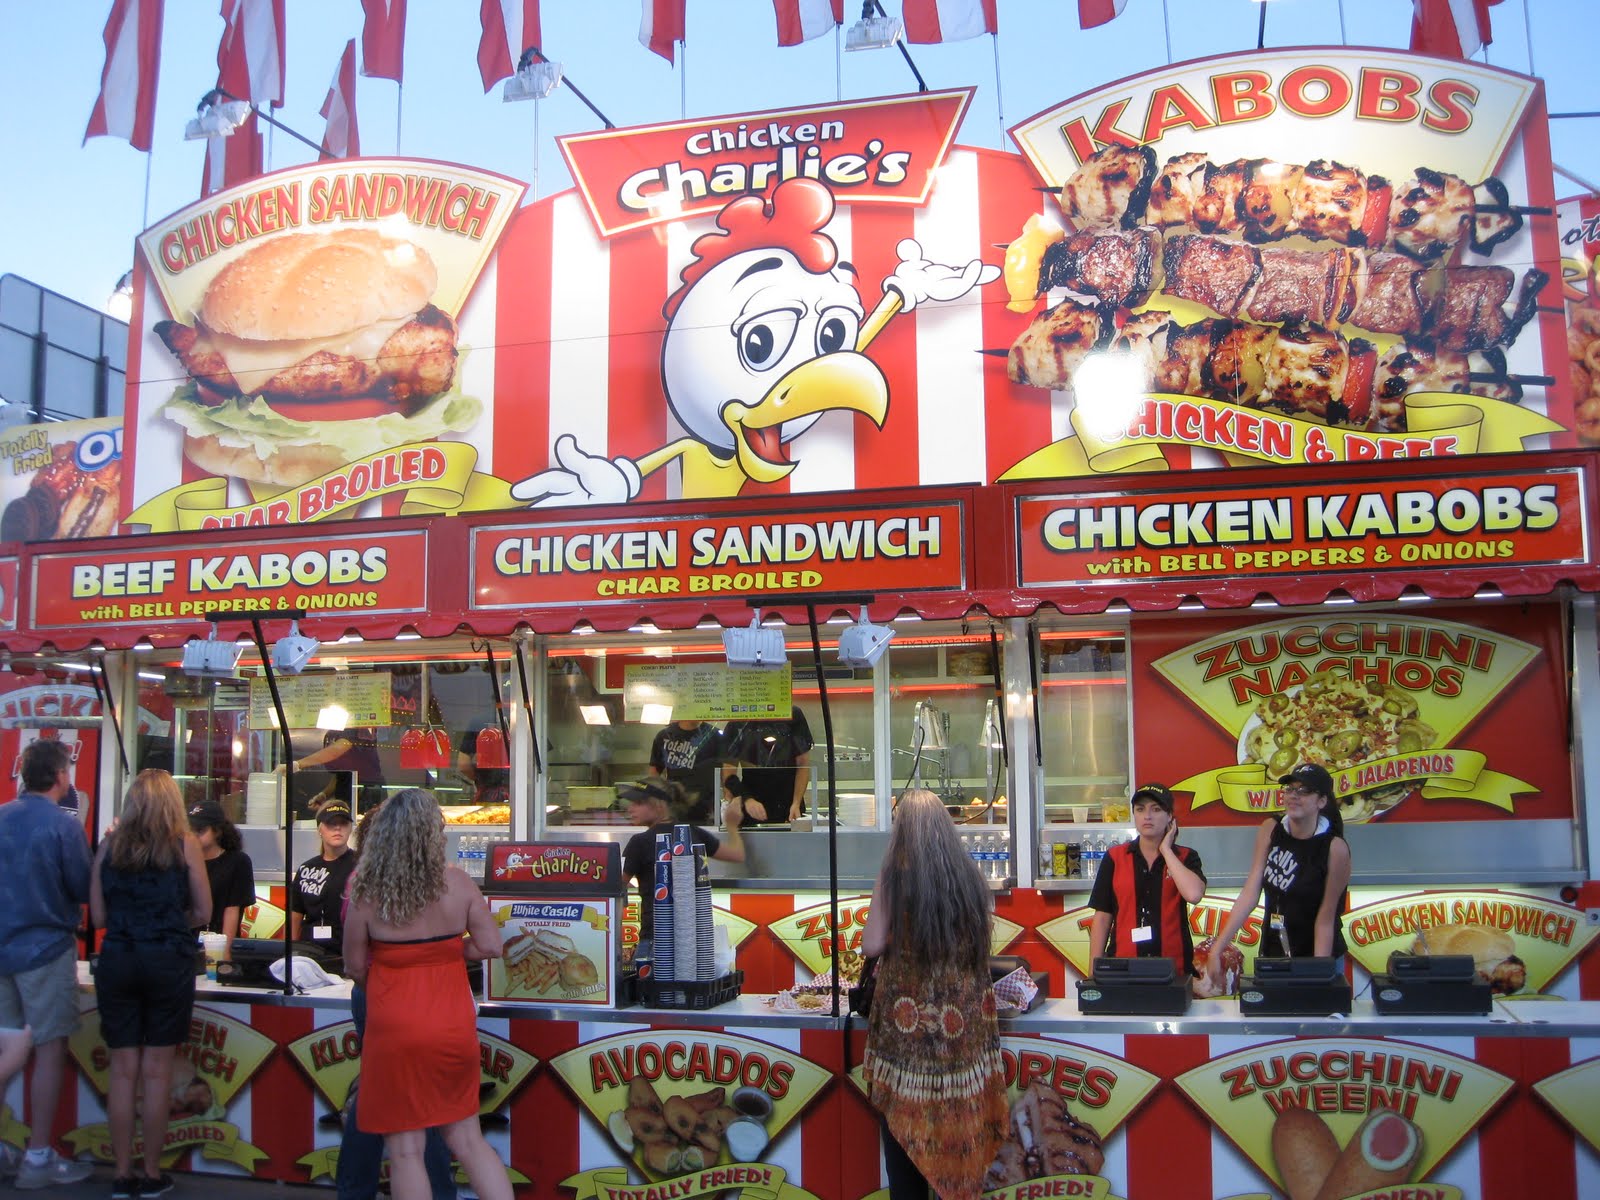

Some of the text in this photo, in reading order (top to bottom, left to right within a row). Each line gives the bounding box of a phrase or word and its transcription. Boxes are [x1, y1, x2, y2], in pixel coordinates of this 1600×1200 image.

[1061, 65, 1481, 159] KABOBS
[685, 119, 846, 156] Chicken
[617, 140, 912, 215] Charlie's
[159, 174, 501, 274] CHICKEN SANDWICH
[0, 430, 49, 459] Totally
[1104, 400, 1293, 458] HICKEN
[1304, 427, 1336, 463] &
[14, 444, 53, 475] Fried
[298, 447, 448, 522] BROILED
[1043, 484, 1560, 551] CHICKEN KABOBS
[494, 516, 941, 575] CHICKEN SANDWICH
[1087, 540, 1514, 575] with BELL PEPPERS & ONIONS
[72, 547, 388, 598] BEEF KABOBS
[597, 570, 823, 597] CHAR BROILED
[80, 591, 378, 619] with BELL PEPPERS & ONIONS
[1195, 623, 1496, 682] ZUCCHINI
[1229, 657, 1465, 705] NACHOS
[663, 738, 698, 758] Totally
[667, 751, 696, 770] Fried
[1340, 777, 1352, 793] &
[1356, 754, 1456, 788] JALAPENOS
[512, 904, 579, 918] White Castle
[1350, 901, 1578, 946] CHICKEN SANDWICH
[590, 1041, 795, 1099] AVOCADOS
[1221, 1050, 1463, 1101] ZUCCHINI
[1263, 1082, 1420, 1121] WEENI
[700, 1167, 772, 1190] FRIED!
[1016, 1180, 1094, 1200] FRIED!
